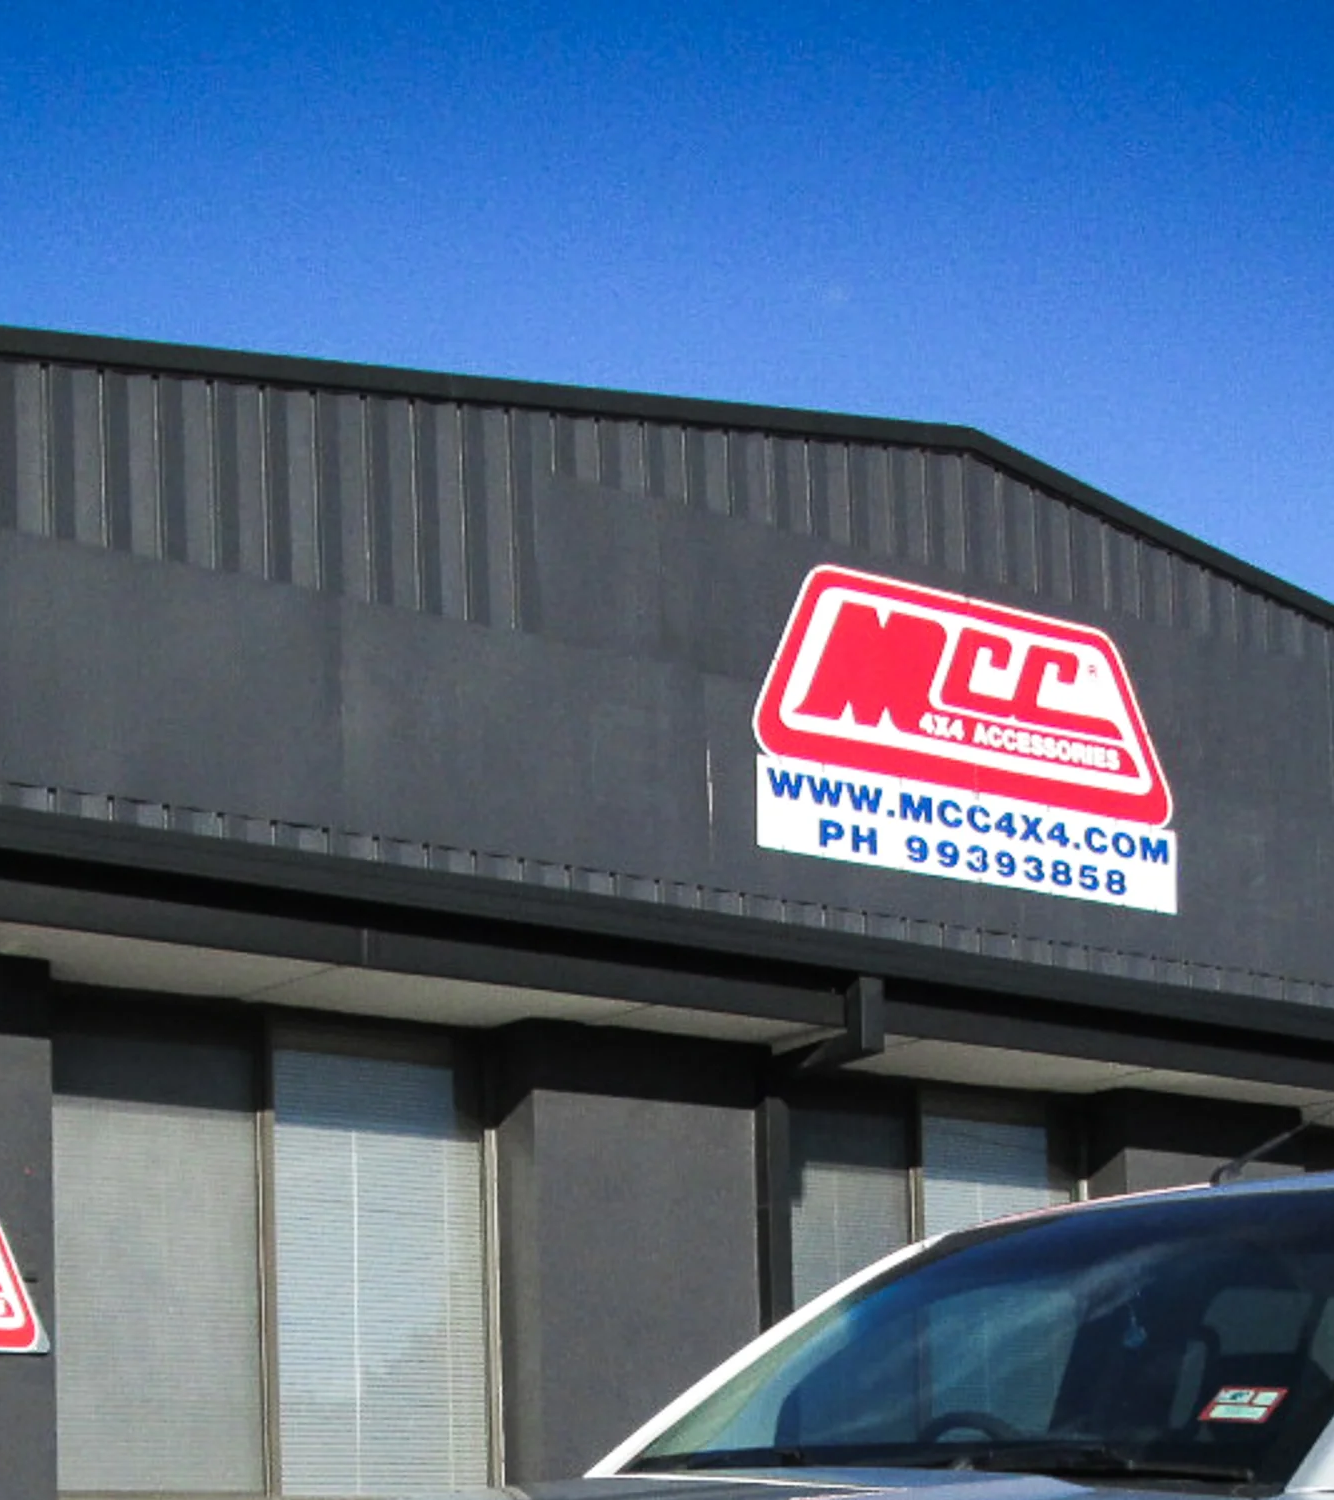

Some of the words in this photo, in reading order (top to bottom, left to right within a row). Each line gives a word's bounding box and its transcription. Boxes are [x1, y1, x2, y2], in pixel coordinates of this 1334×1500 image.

[792, 600, 1125, 741] MCC
[919, 711, 966, 741] 4X4
[972, 725, 1121, 772] ACCESSORIES
[767, 767, 1169, 865] WWW.MCC4X4.COM
[818, 819, 879, 855] PH
[905, 835, 1127, 895] 99393858
